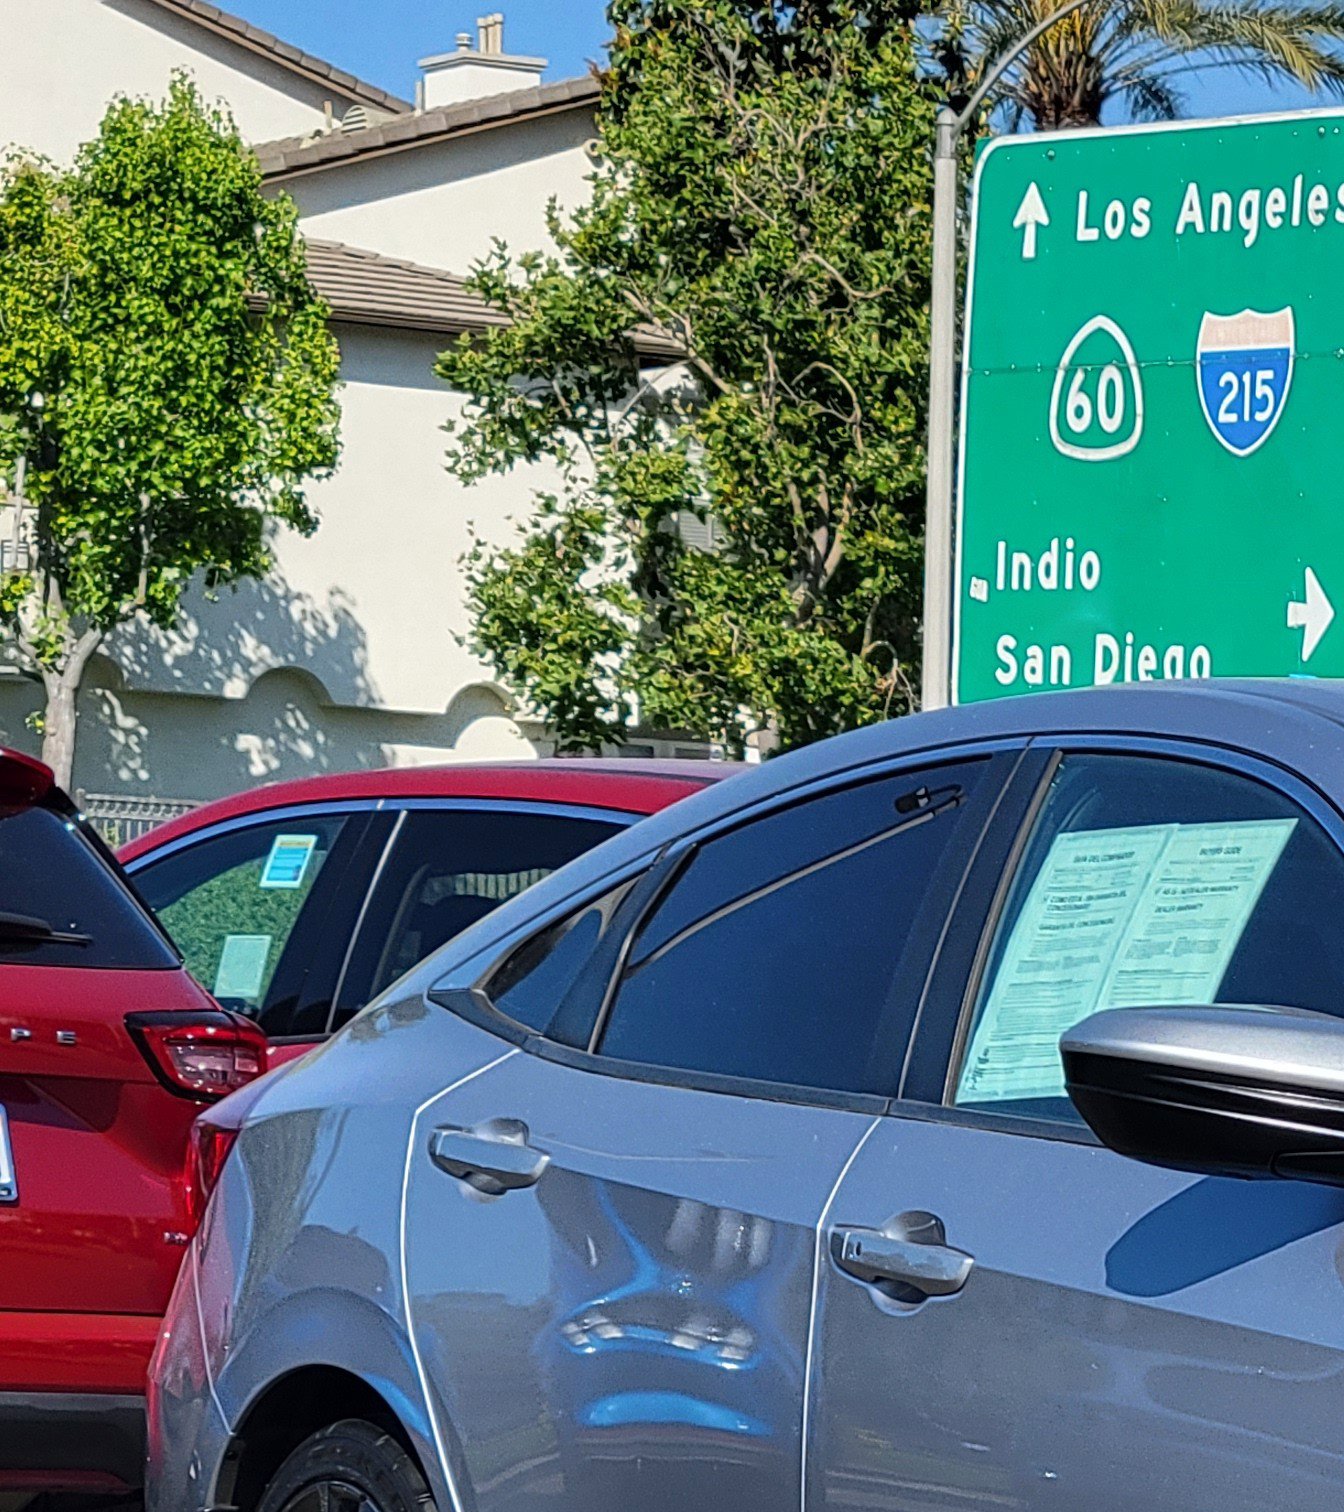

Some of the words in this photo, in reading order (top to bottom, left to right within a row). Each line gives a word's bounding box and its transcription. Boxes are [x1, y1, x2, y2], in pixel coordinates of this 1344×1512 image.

[1076, 190, 1151, 242] Los
[1065, 364, 1125, 434] 60
[1217, 369, 1276, 424] 215
[996, 537, 1101, 592] Indio
[995, 633, 1071, 686] San
